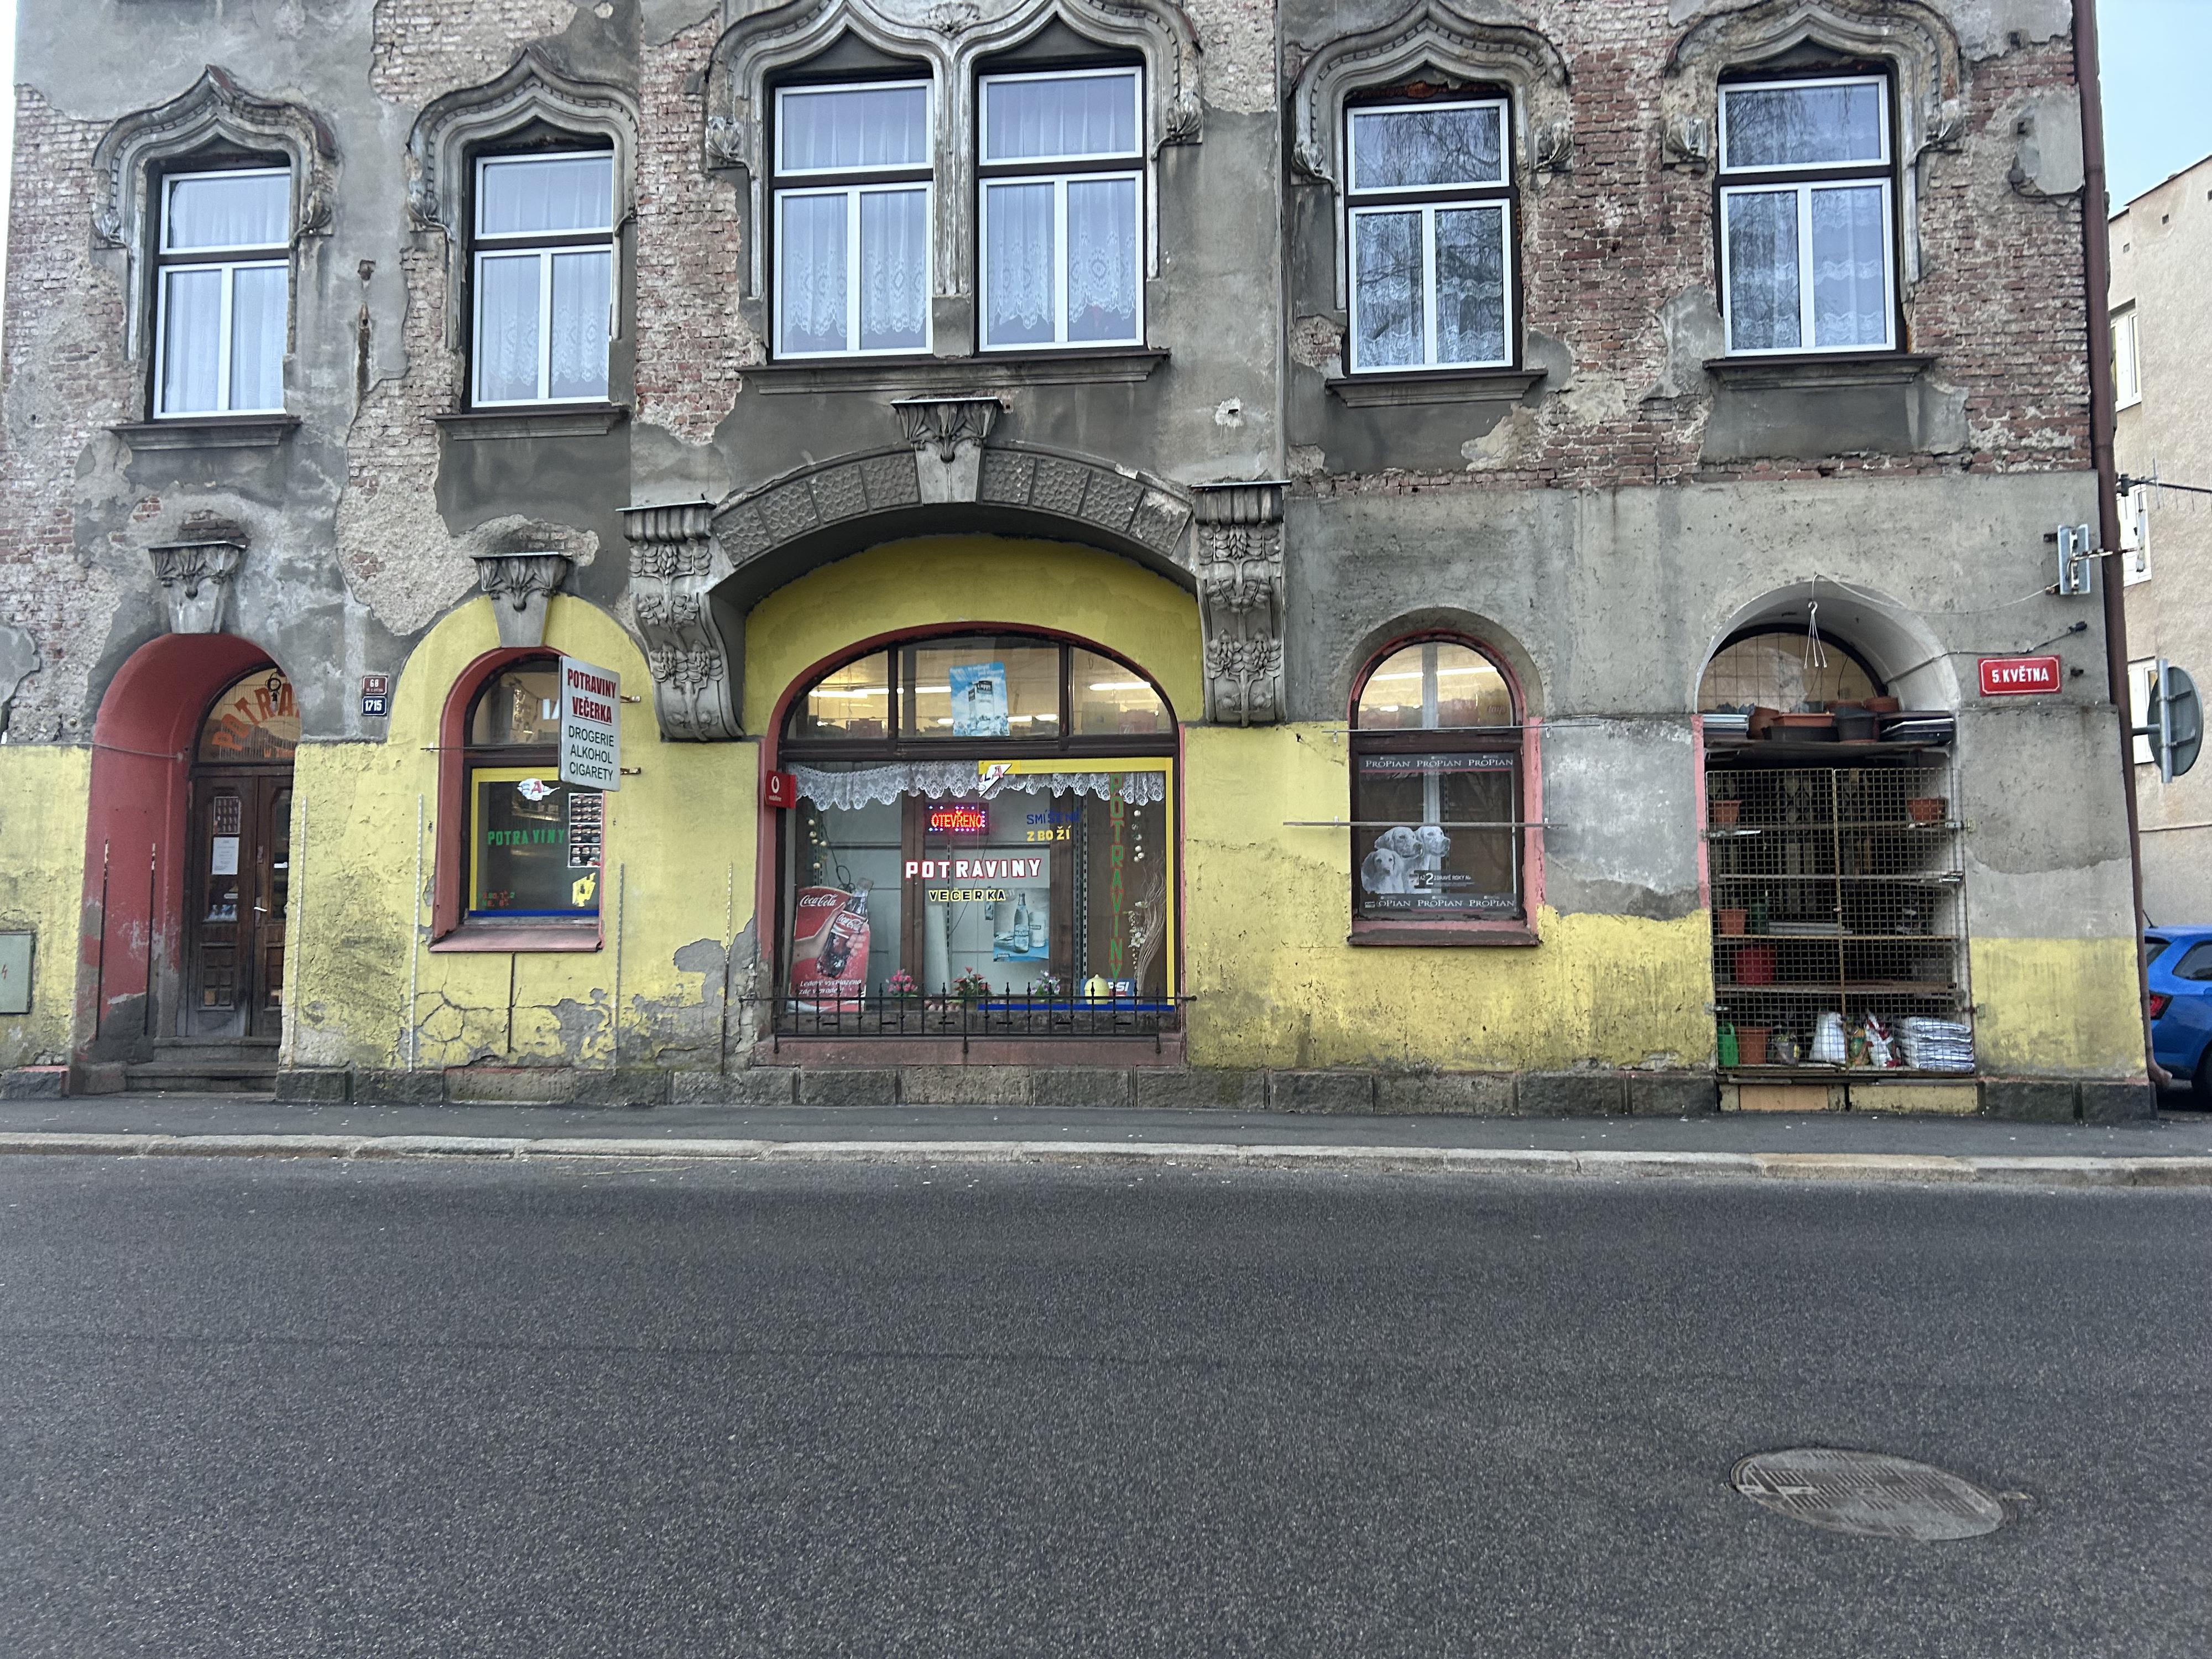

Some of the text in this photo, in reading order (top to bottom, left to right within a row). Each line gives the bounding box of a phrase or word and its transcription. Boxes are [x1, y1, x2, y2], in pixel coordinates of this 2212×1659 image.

[568, 668, 616, 699] POTRAVINY
[1991, 665, 2049, 683] 5. KVĚTNA
[365, 700, 382, 711] 1715
[572, 696, 612, 724] VEČERKA
[212, 683, 300, 752] POTRA
[568, 725, 614, 747] DROGERIE
[570, 744, 613, 764] ALKOHOL
[569, 761, 614, 781] CIGARETY
[931, 810, 983, 828] OTEVŘENO
[488, 829, 564, 846] POTRAVINY
[1026, 825, 1071, 842] ZBOŽÍ
[905, 858, 1041, 879] POTRAVINY
[1426, 873, 1433, 885] 2
[928, 887, 1006, 902] VEČERKA
